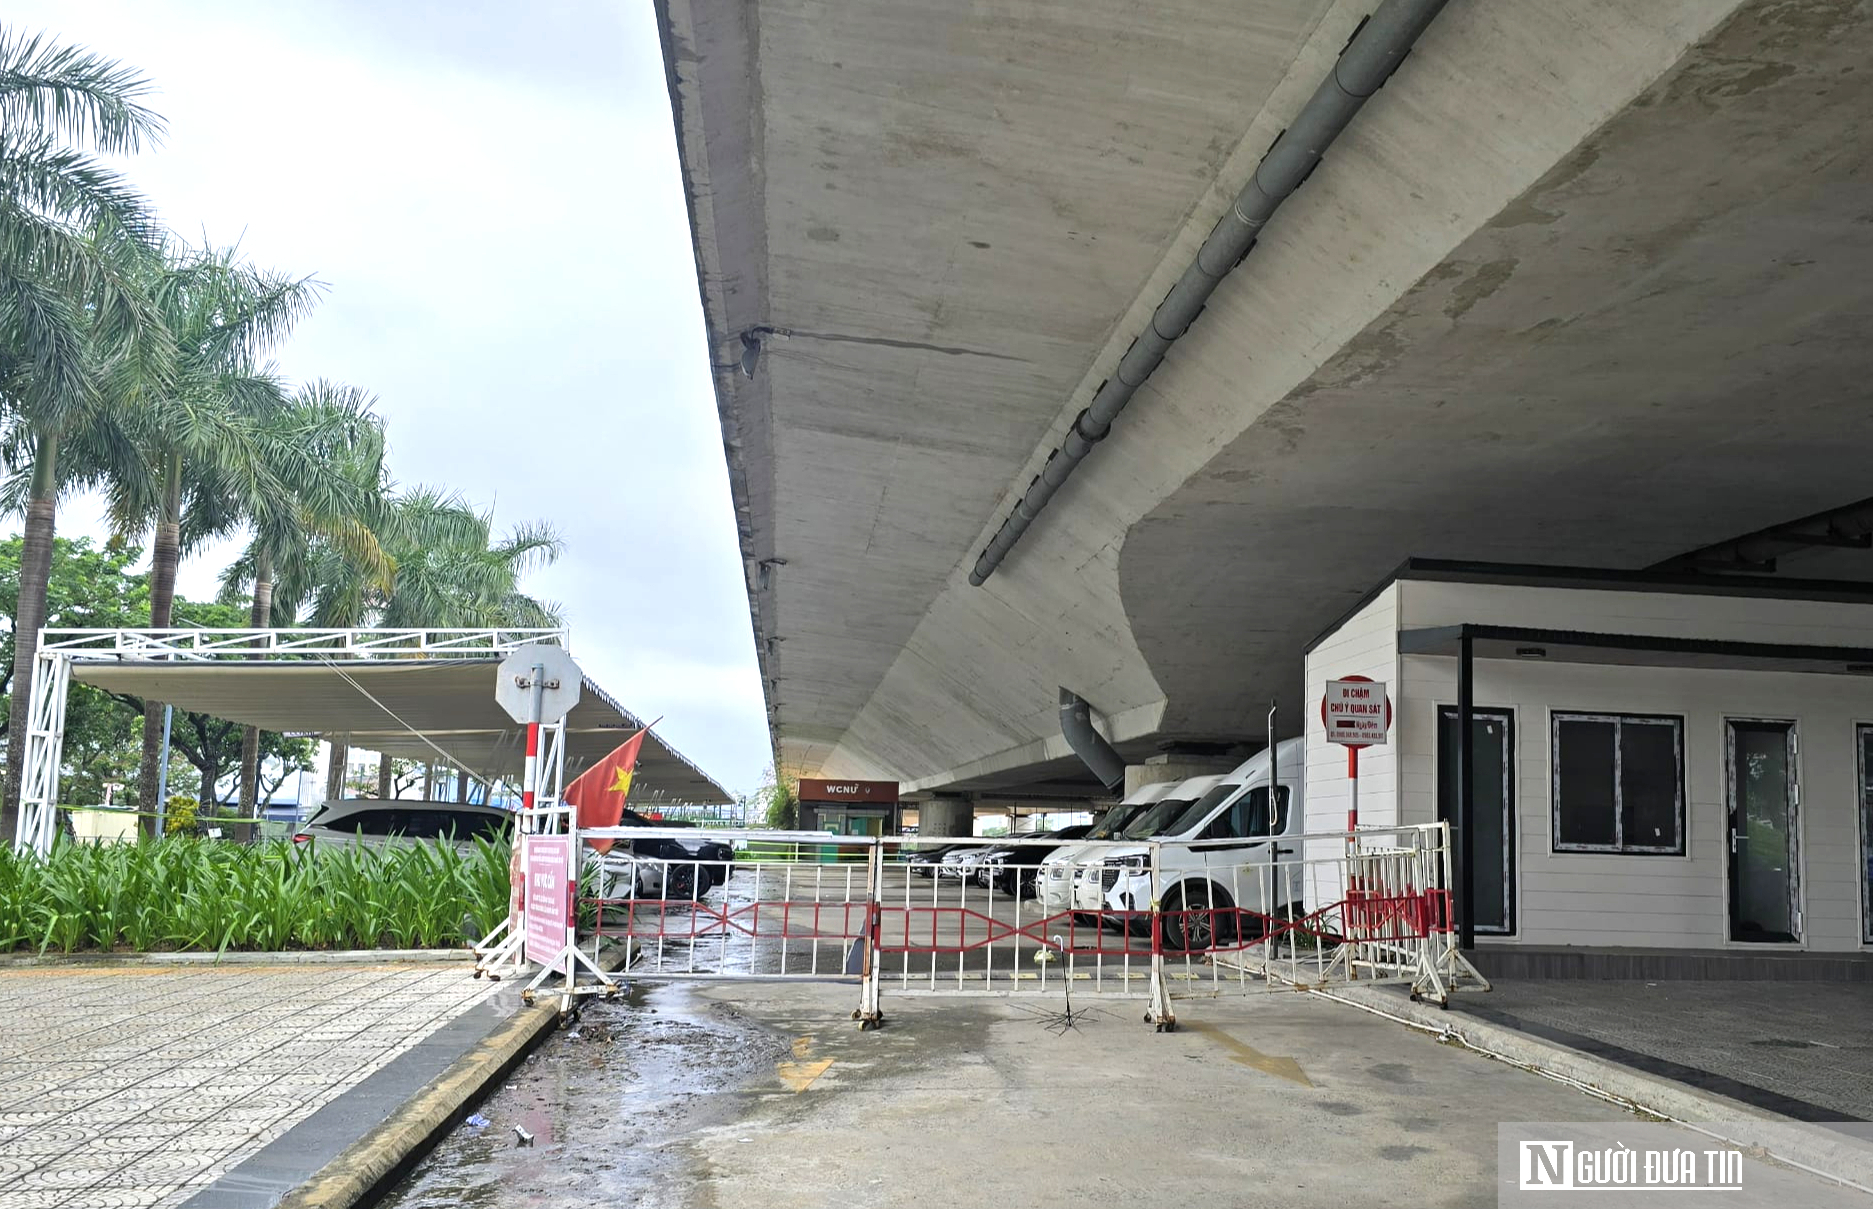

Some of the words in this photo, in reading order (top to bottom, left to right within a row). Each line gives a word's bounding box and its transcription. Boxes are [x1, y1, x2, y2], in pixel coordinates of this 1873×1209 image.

[1342, 688, 1350, 698] ĐI
[1350, 687, 1370, 700] CHẬM
[1330, 701, 1344, 713] CHÚ
[1350, 704, 1368, 714] QUAN
[1368, 702, 1381, 714] SÁT
